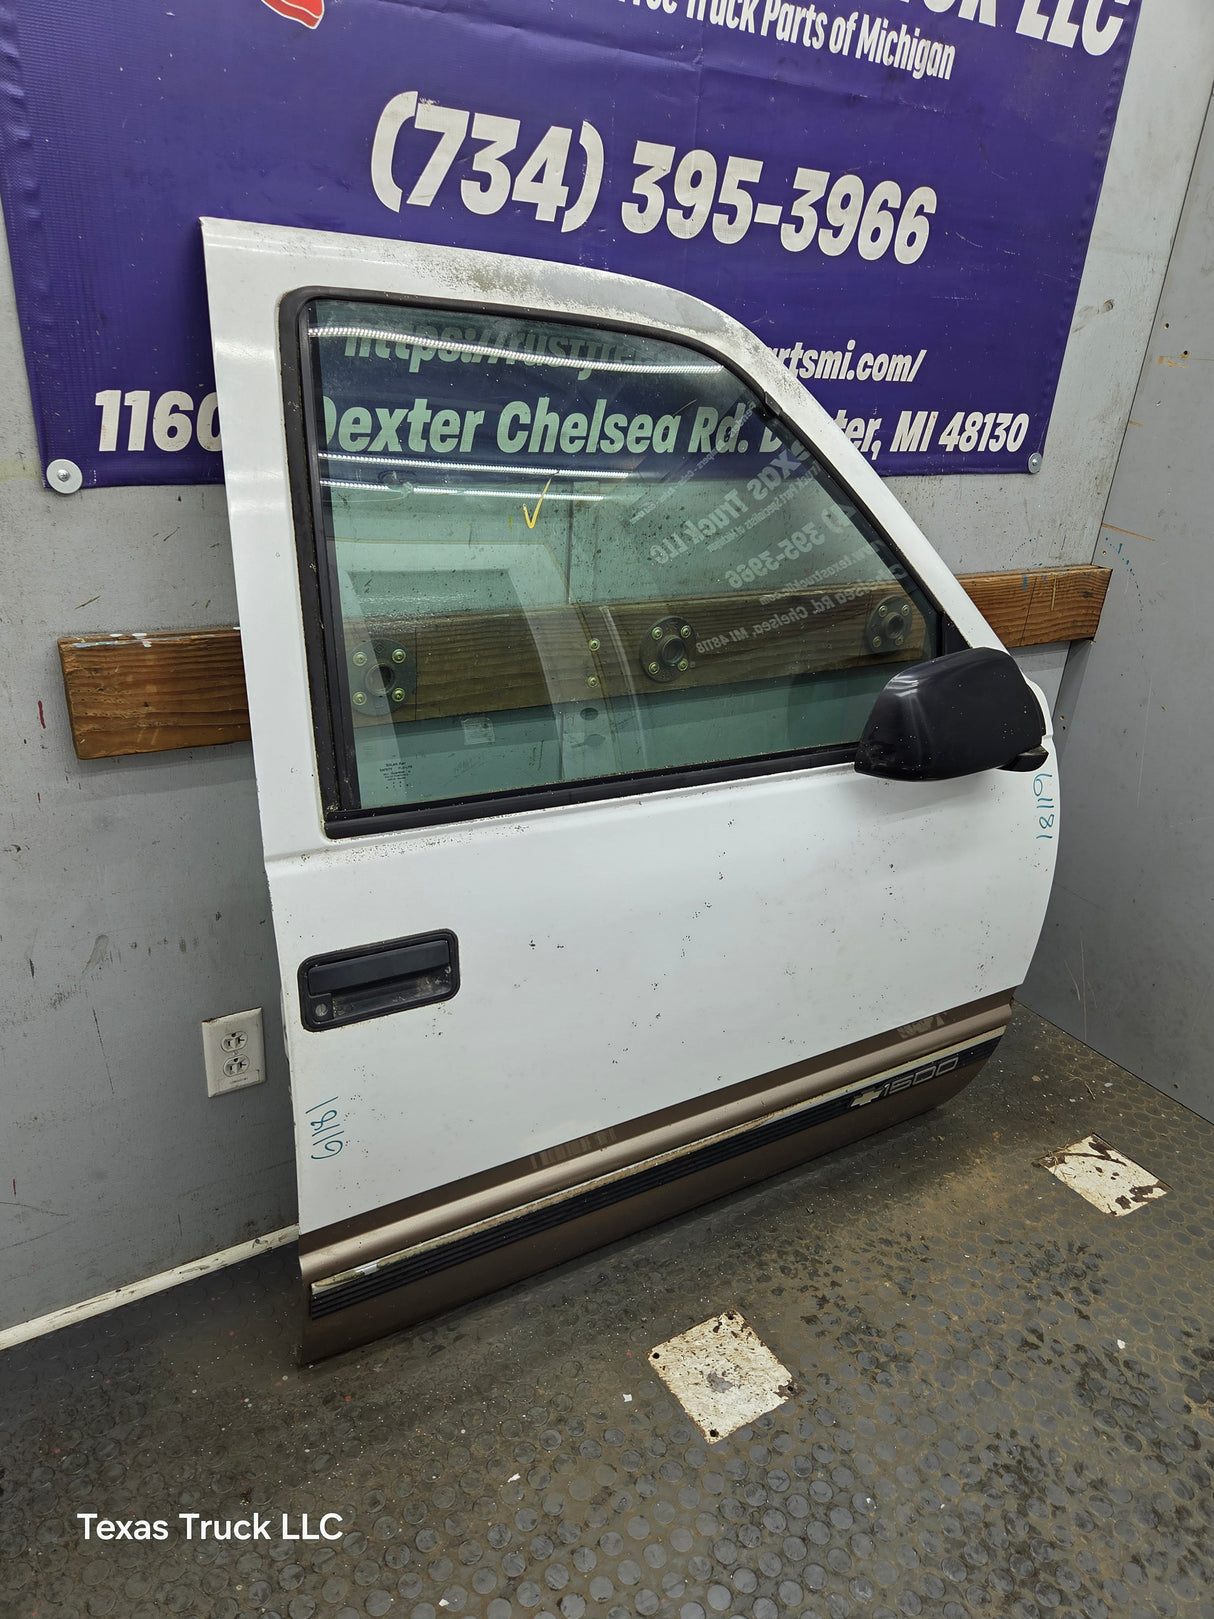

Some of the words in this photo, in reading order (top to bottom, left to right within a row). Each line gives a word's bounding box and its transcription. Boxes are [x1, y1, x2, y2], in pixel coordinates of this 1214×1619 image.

[761, 0, 829, 50] Parts
[828, 11, 859, 59] of
[855, 16, 956, 81] Michigan
[370, 90, 605, 233] (734)
[620, 139, 938, 265] 395-3966
[496, 395, 683, 454] Chelsea
[687, 402, 749, 454] Rd.
[889, 410, 939, 452] MI
[939, 411, 1029, 453] 48130
[882, 1055, 960, 1098] 1500
